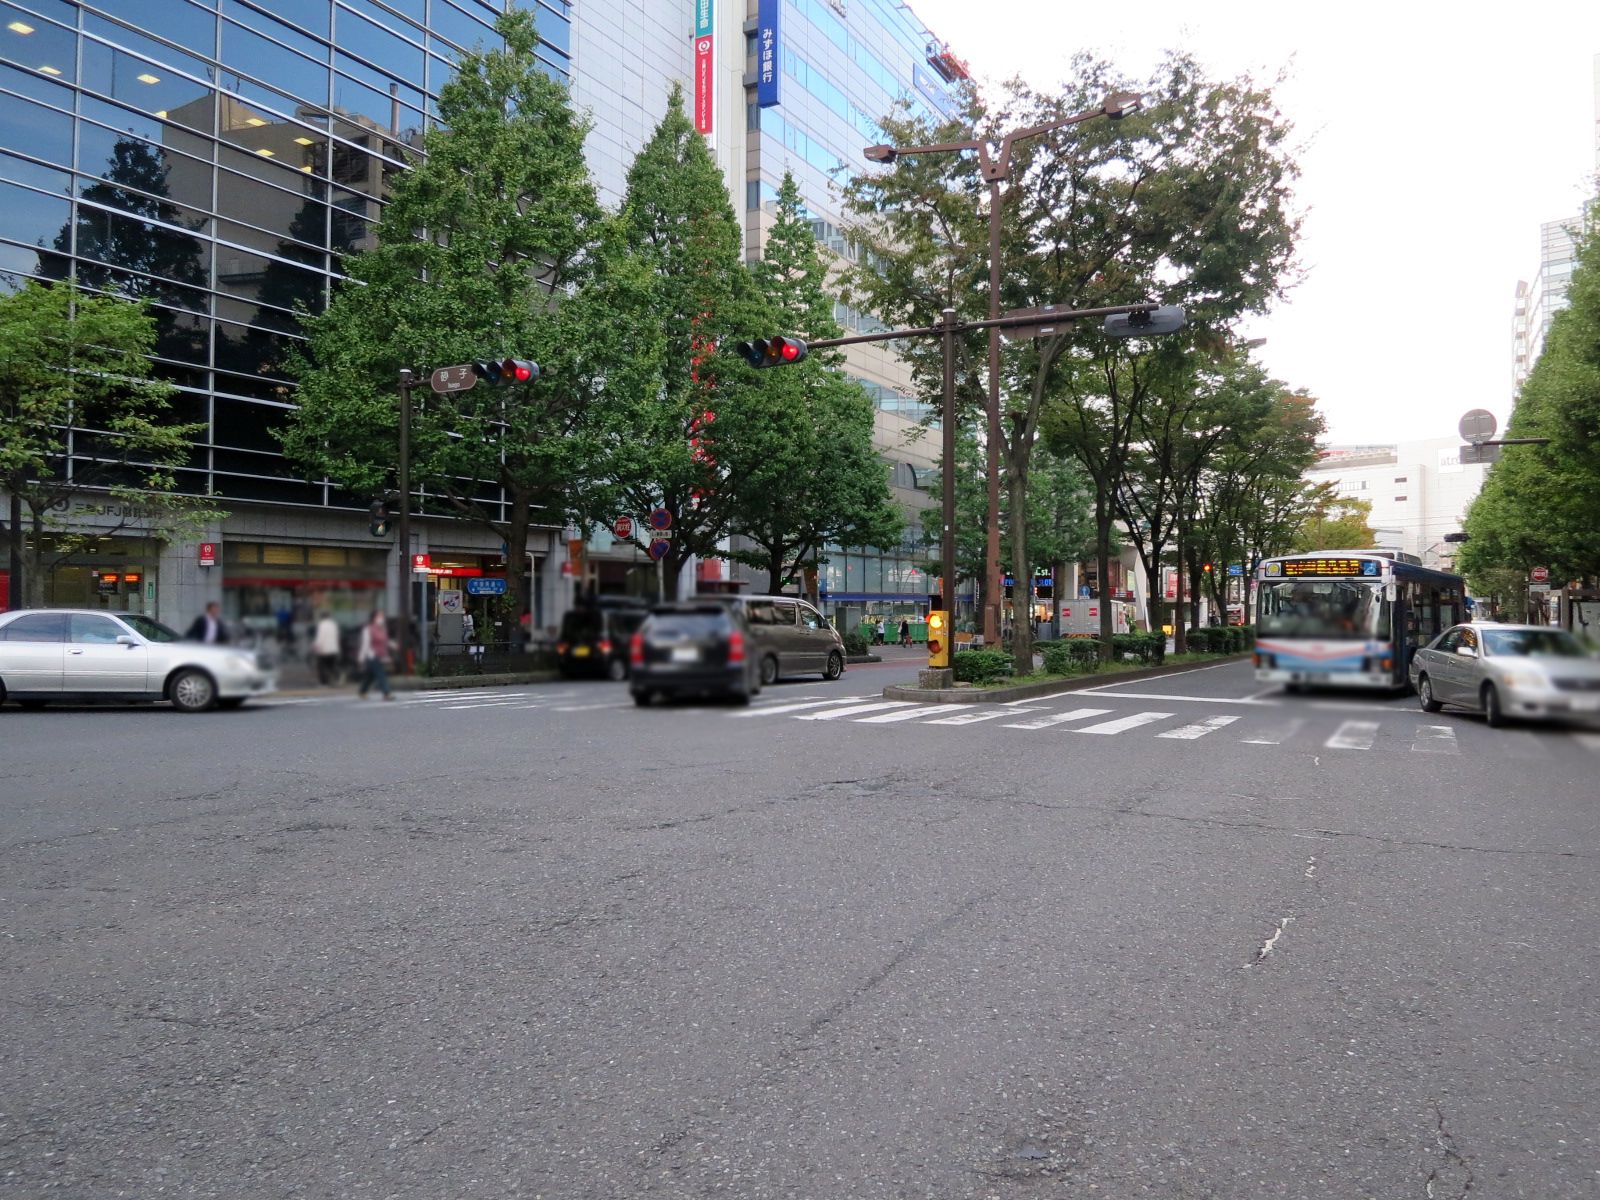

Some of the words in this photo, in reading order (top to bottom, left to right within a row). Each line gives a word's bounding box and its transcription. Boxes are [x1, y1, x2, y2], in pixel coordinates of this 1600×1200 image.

[762, 28, 773, 83] みずほ銀行
[441, 368, 467, 382] 砂子
